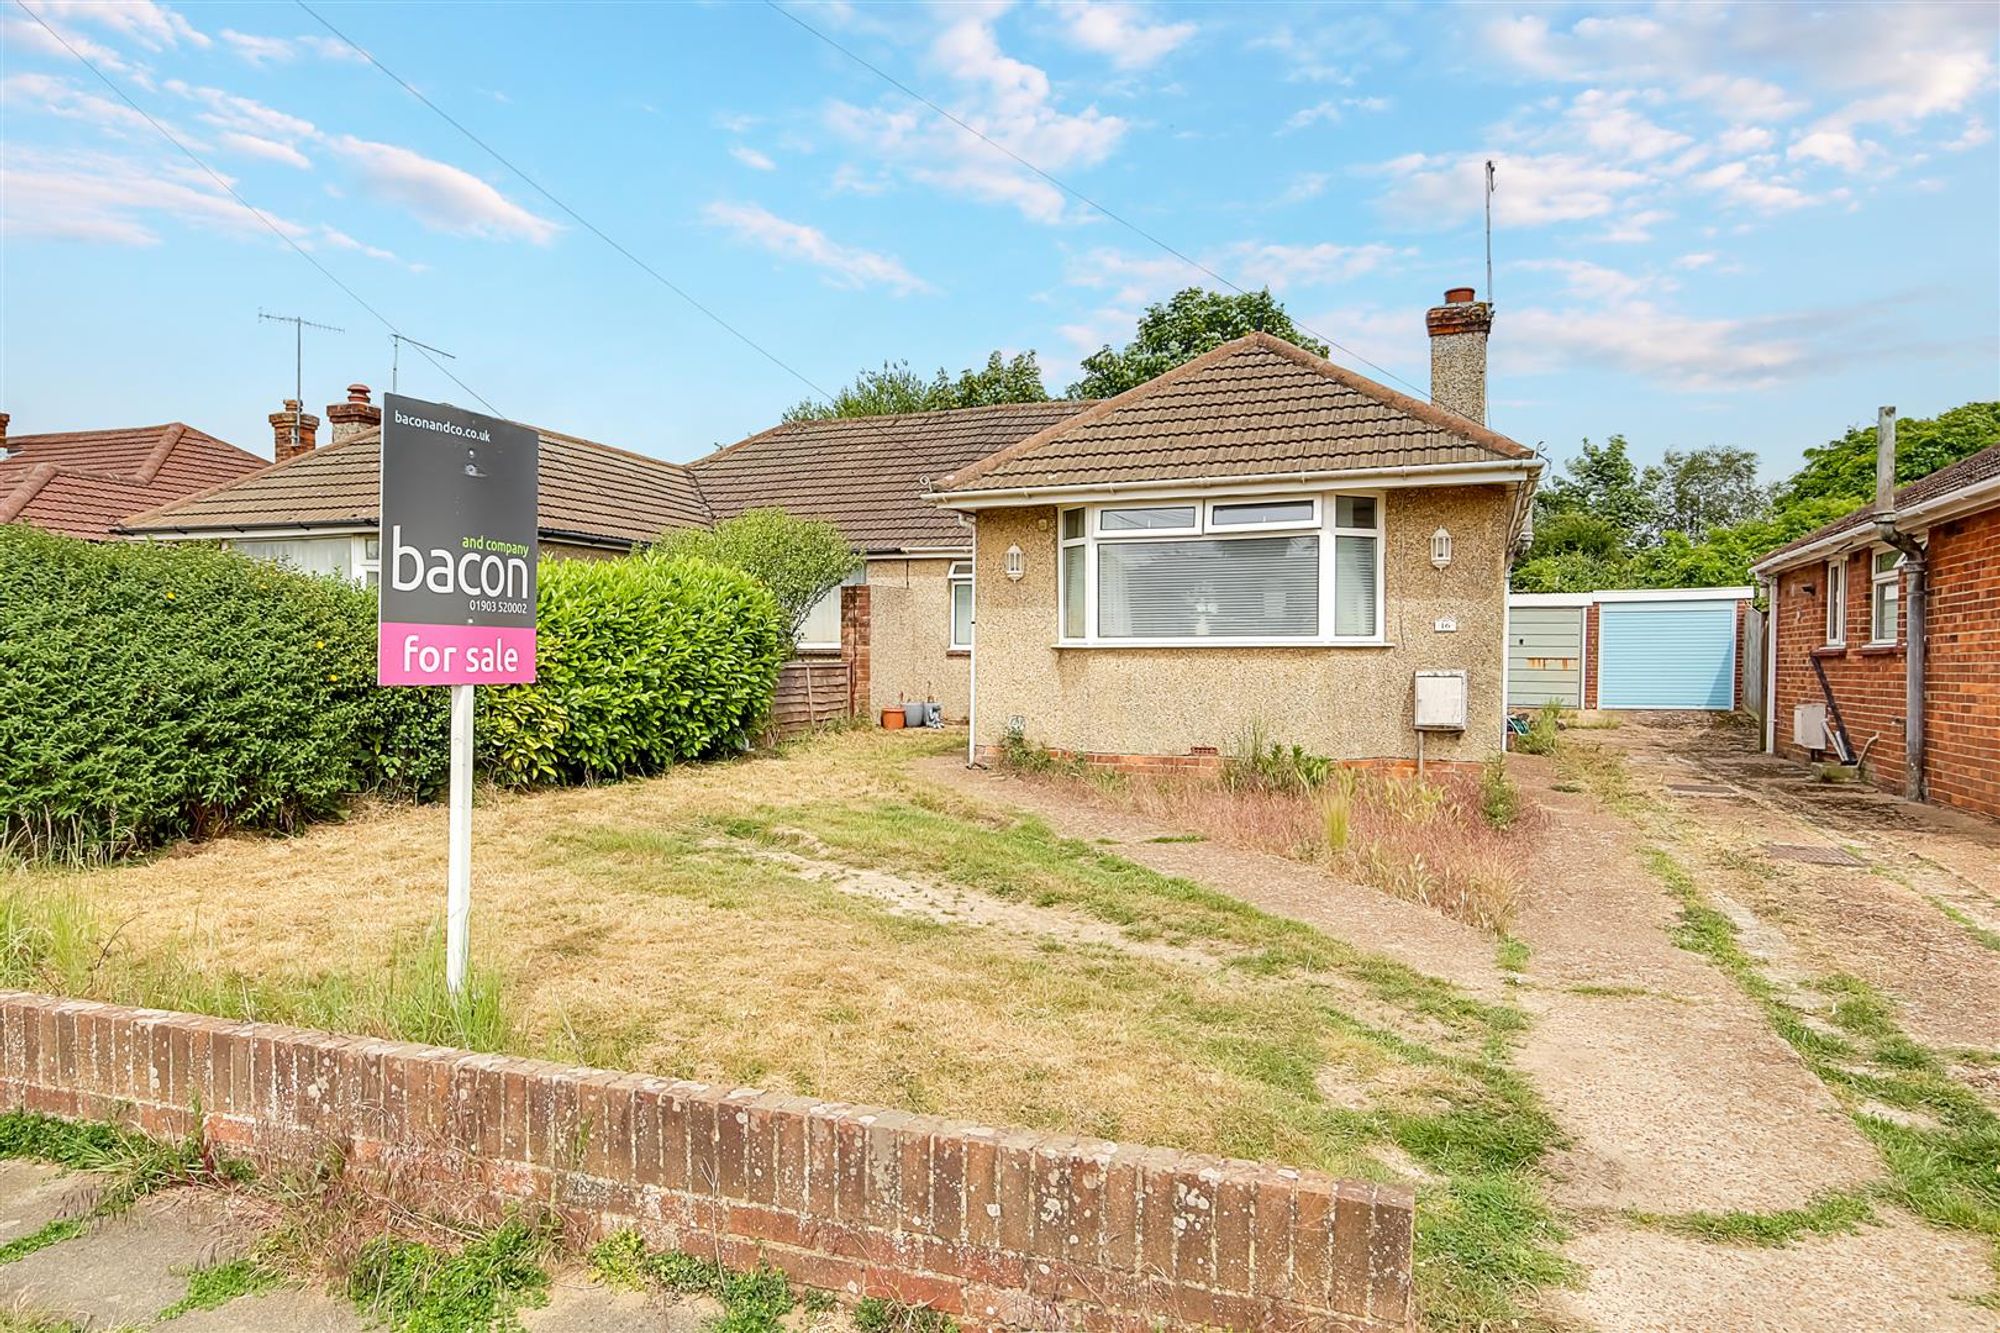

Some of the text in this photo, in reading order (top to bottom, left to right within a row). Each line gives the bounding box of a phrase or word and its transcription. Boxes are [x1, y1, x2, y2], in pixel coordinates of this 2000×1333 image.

[395, 410, 491, 442] baconandco.co.uk
[462, 535, 529, 557] and company
[392, 525, 528, 599] bacon
[469, 600, 528, 615] 01903 520002
[1440, 621, 1451, 629] 16
[403, 634, 519, 673] for sale
